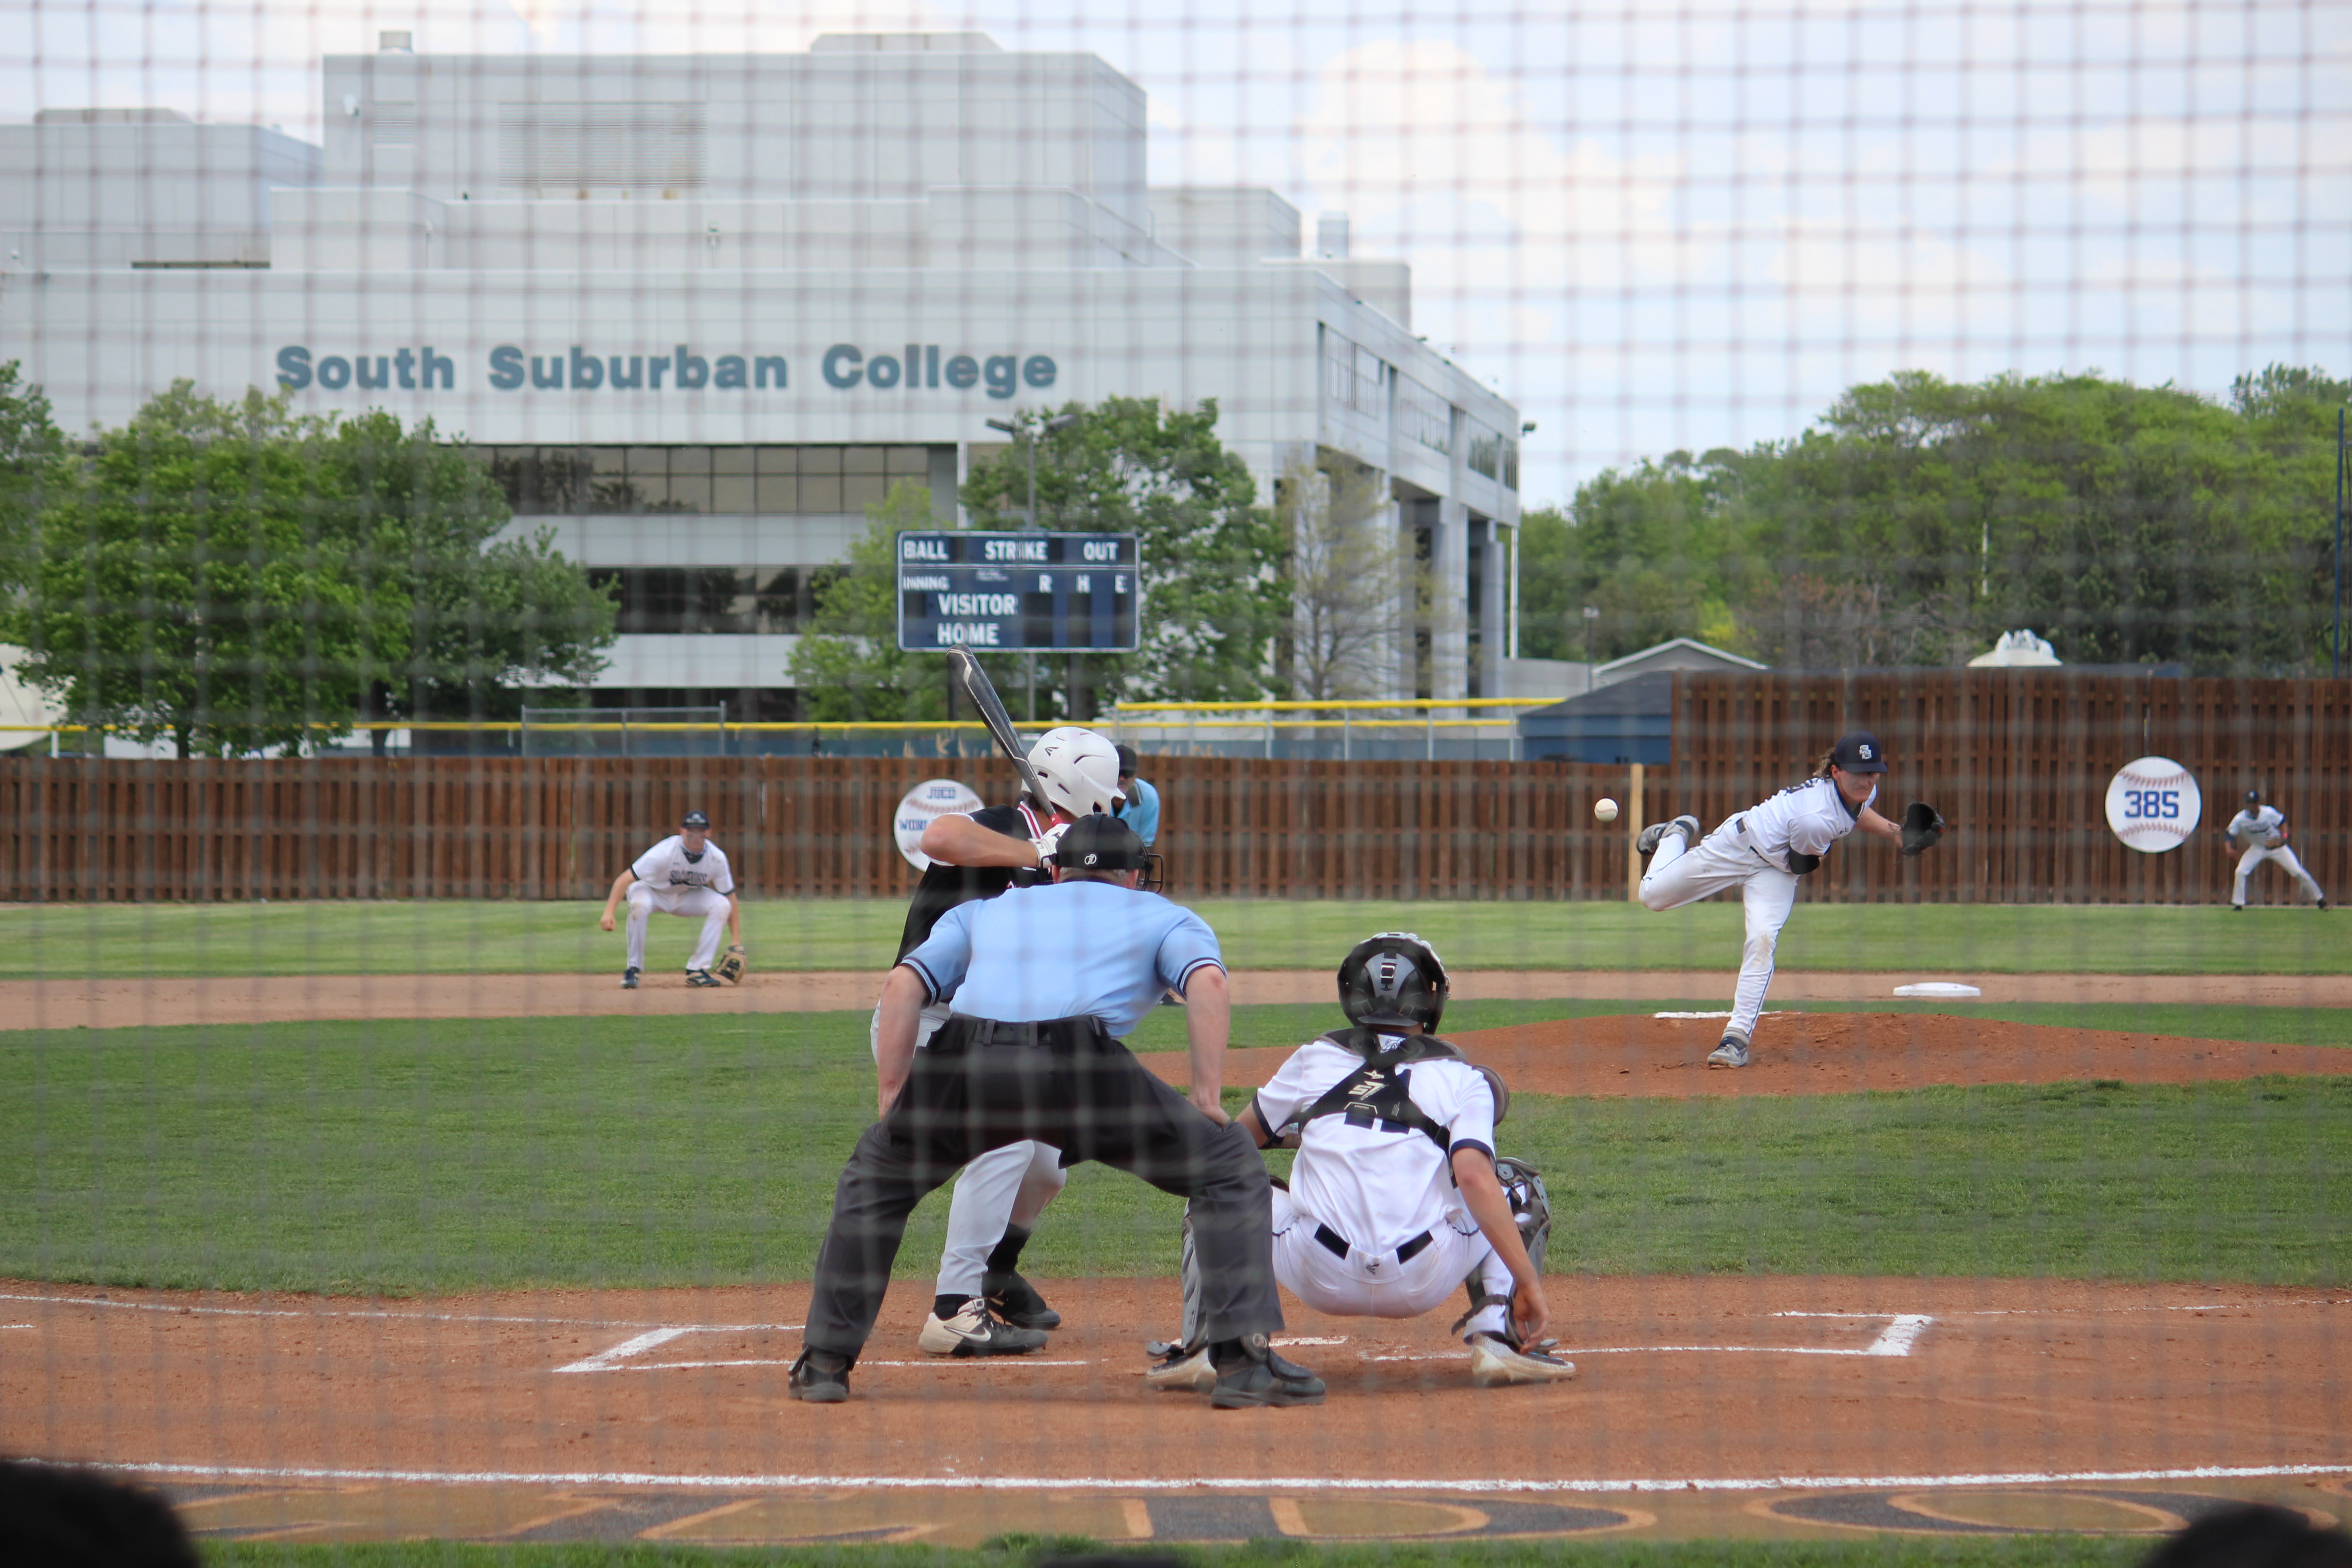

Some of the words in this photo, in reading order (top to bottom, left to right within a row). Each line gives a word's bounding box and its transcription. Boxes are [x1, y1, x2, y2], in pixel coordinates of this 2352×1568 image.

[275, 345, 454, 389] South
[489, 345, 787, 389] Suburban
[822, 343, 1057, 399] College
[903, 540, 949, 560] BALL
[984, 541, 1048, 561] STRIKE
[1083, 542, 1119, 561] OUT
[903, 575, 950, 590] INNING
[1039, 574, 1053, 593] R
[1076, 574, 1091, 593] H
[1115, 574, 1127, 593] E
[938, 593, 1018, 616] VISITOR
[937, 622, 1000, 645] HOME
[927, 787, 956, 799] JUCO
[2125, 790, 2179, 818] 385
